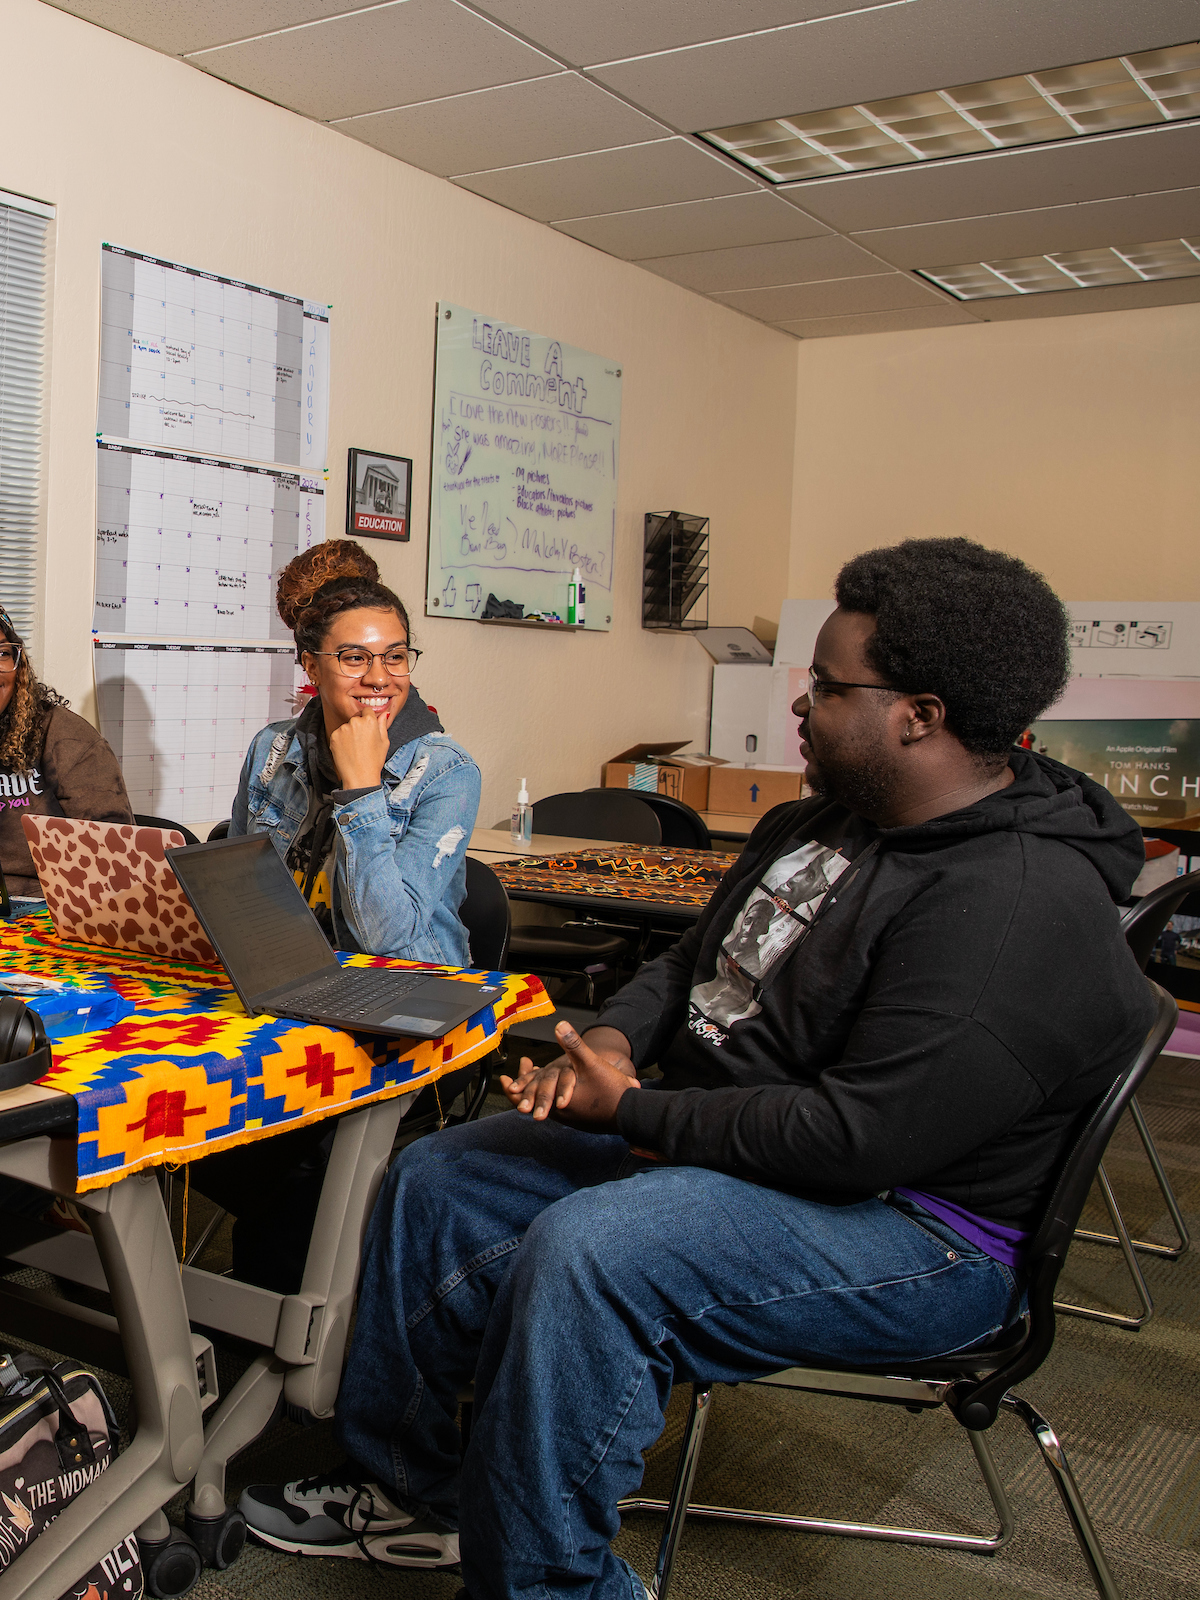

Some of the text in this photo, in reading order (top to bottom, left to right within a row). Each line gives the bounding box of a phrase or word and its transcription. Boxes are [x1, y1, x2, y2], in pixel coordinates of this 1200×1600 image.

[472, 318, 563, 379] LEAVE A
[480, 359, 587, 414] Comment
[487, 404, 505, 424] the
[358, 516, 403, 532] EDUCATION
[1115, 745, 1134, 753] Apple
[1135, 745, 1161, 754] Original
[1110, 761, 1171, 771] TOM HANKS
[1085, 772, 1200, 798] INCH
[7, 797, 31, 810] YOU
[1143, 804, 1160, 812] Now
[27, 1478, 57, 1511] THE
